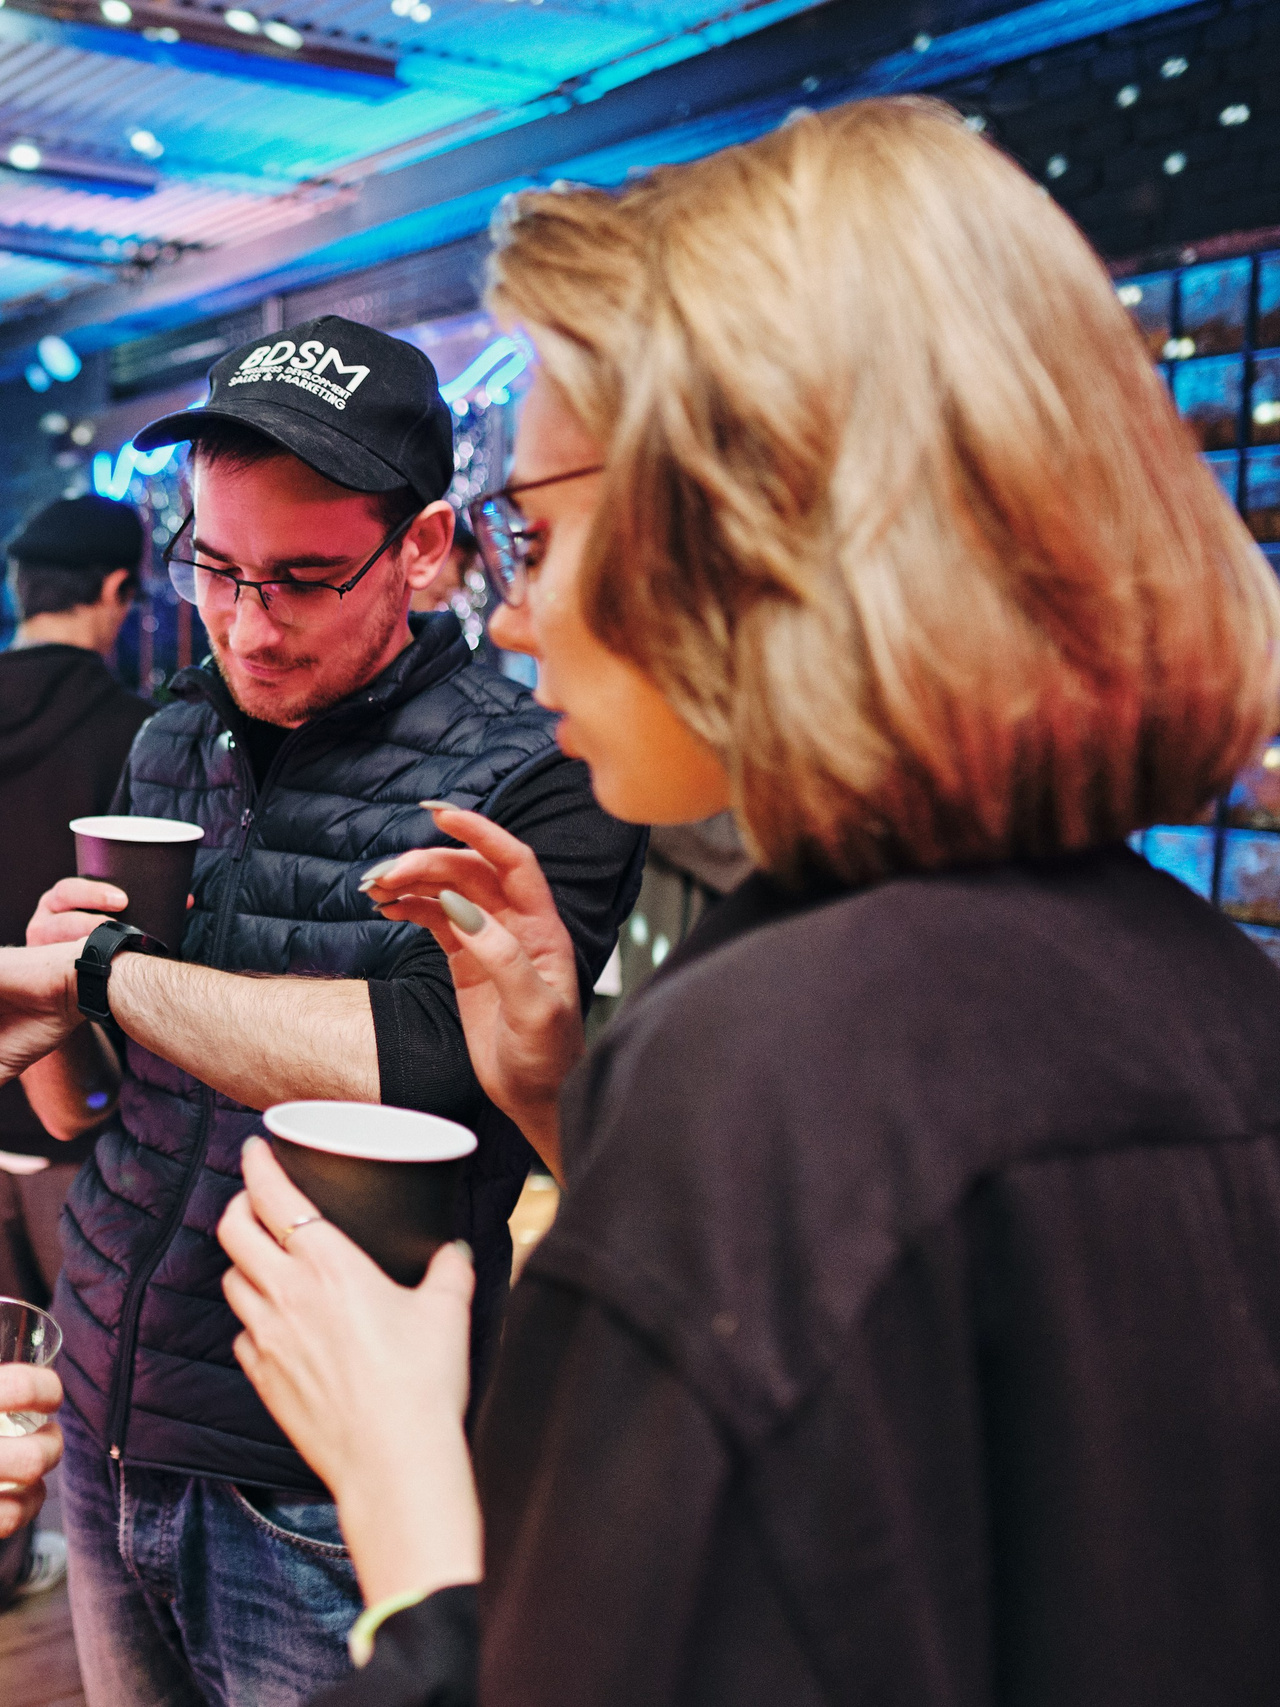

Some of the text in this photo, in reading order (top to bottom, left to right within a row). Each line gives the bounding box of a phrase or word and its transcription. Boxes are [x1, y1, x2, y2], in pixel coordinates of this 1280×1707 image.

[239, 340, 370, 393] BDSM
[284, 366, 352, 400] DEVELOPMENT
[262, 372, 273, 382] &
[276, 373, 347, 411] MARKETING
